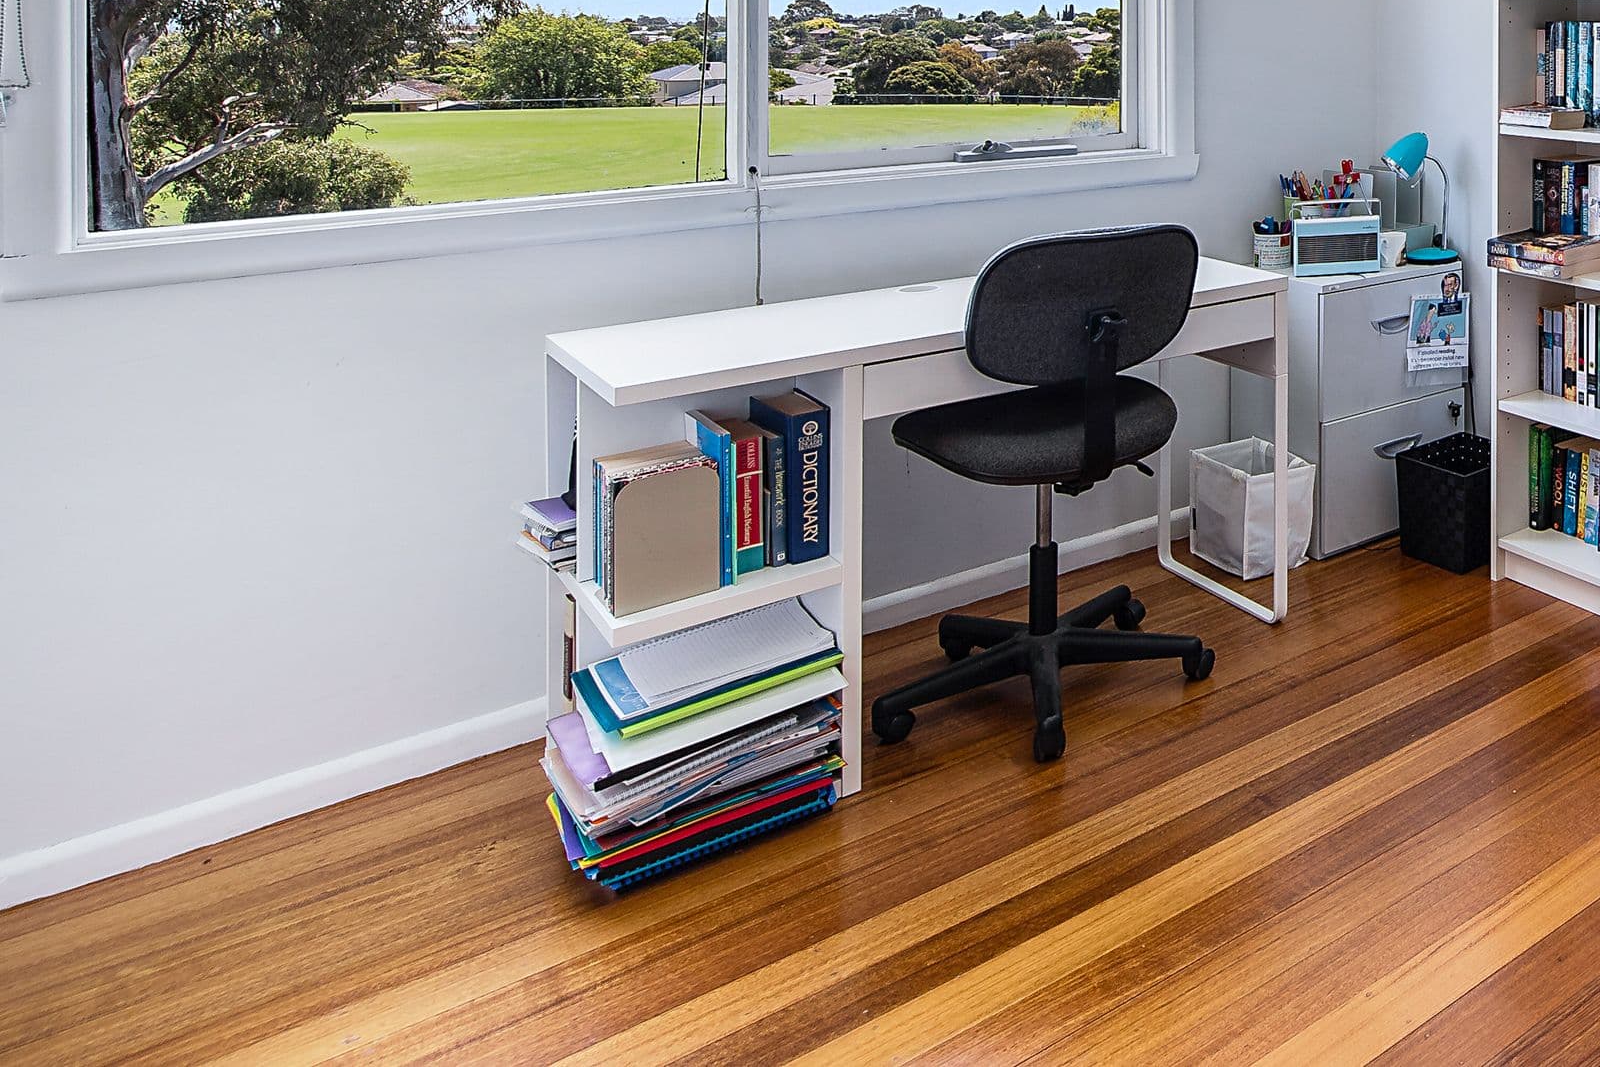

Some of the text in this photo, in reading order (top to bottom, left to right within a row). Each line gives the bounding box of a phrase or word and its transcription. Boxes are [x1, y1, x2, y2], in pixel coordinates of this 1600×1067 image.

[746, 441, 757, 470] COLLINS
[802, 450, 819, 544] DICTIONARY
[1553, 467, 1562, 508] WOOL
[1567, 470, 1578, 513] SHIFT
